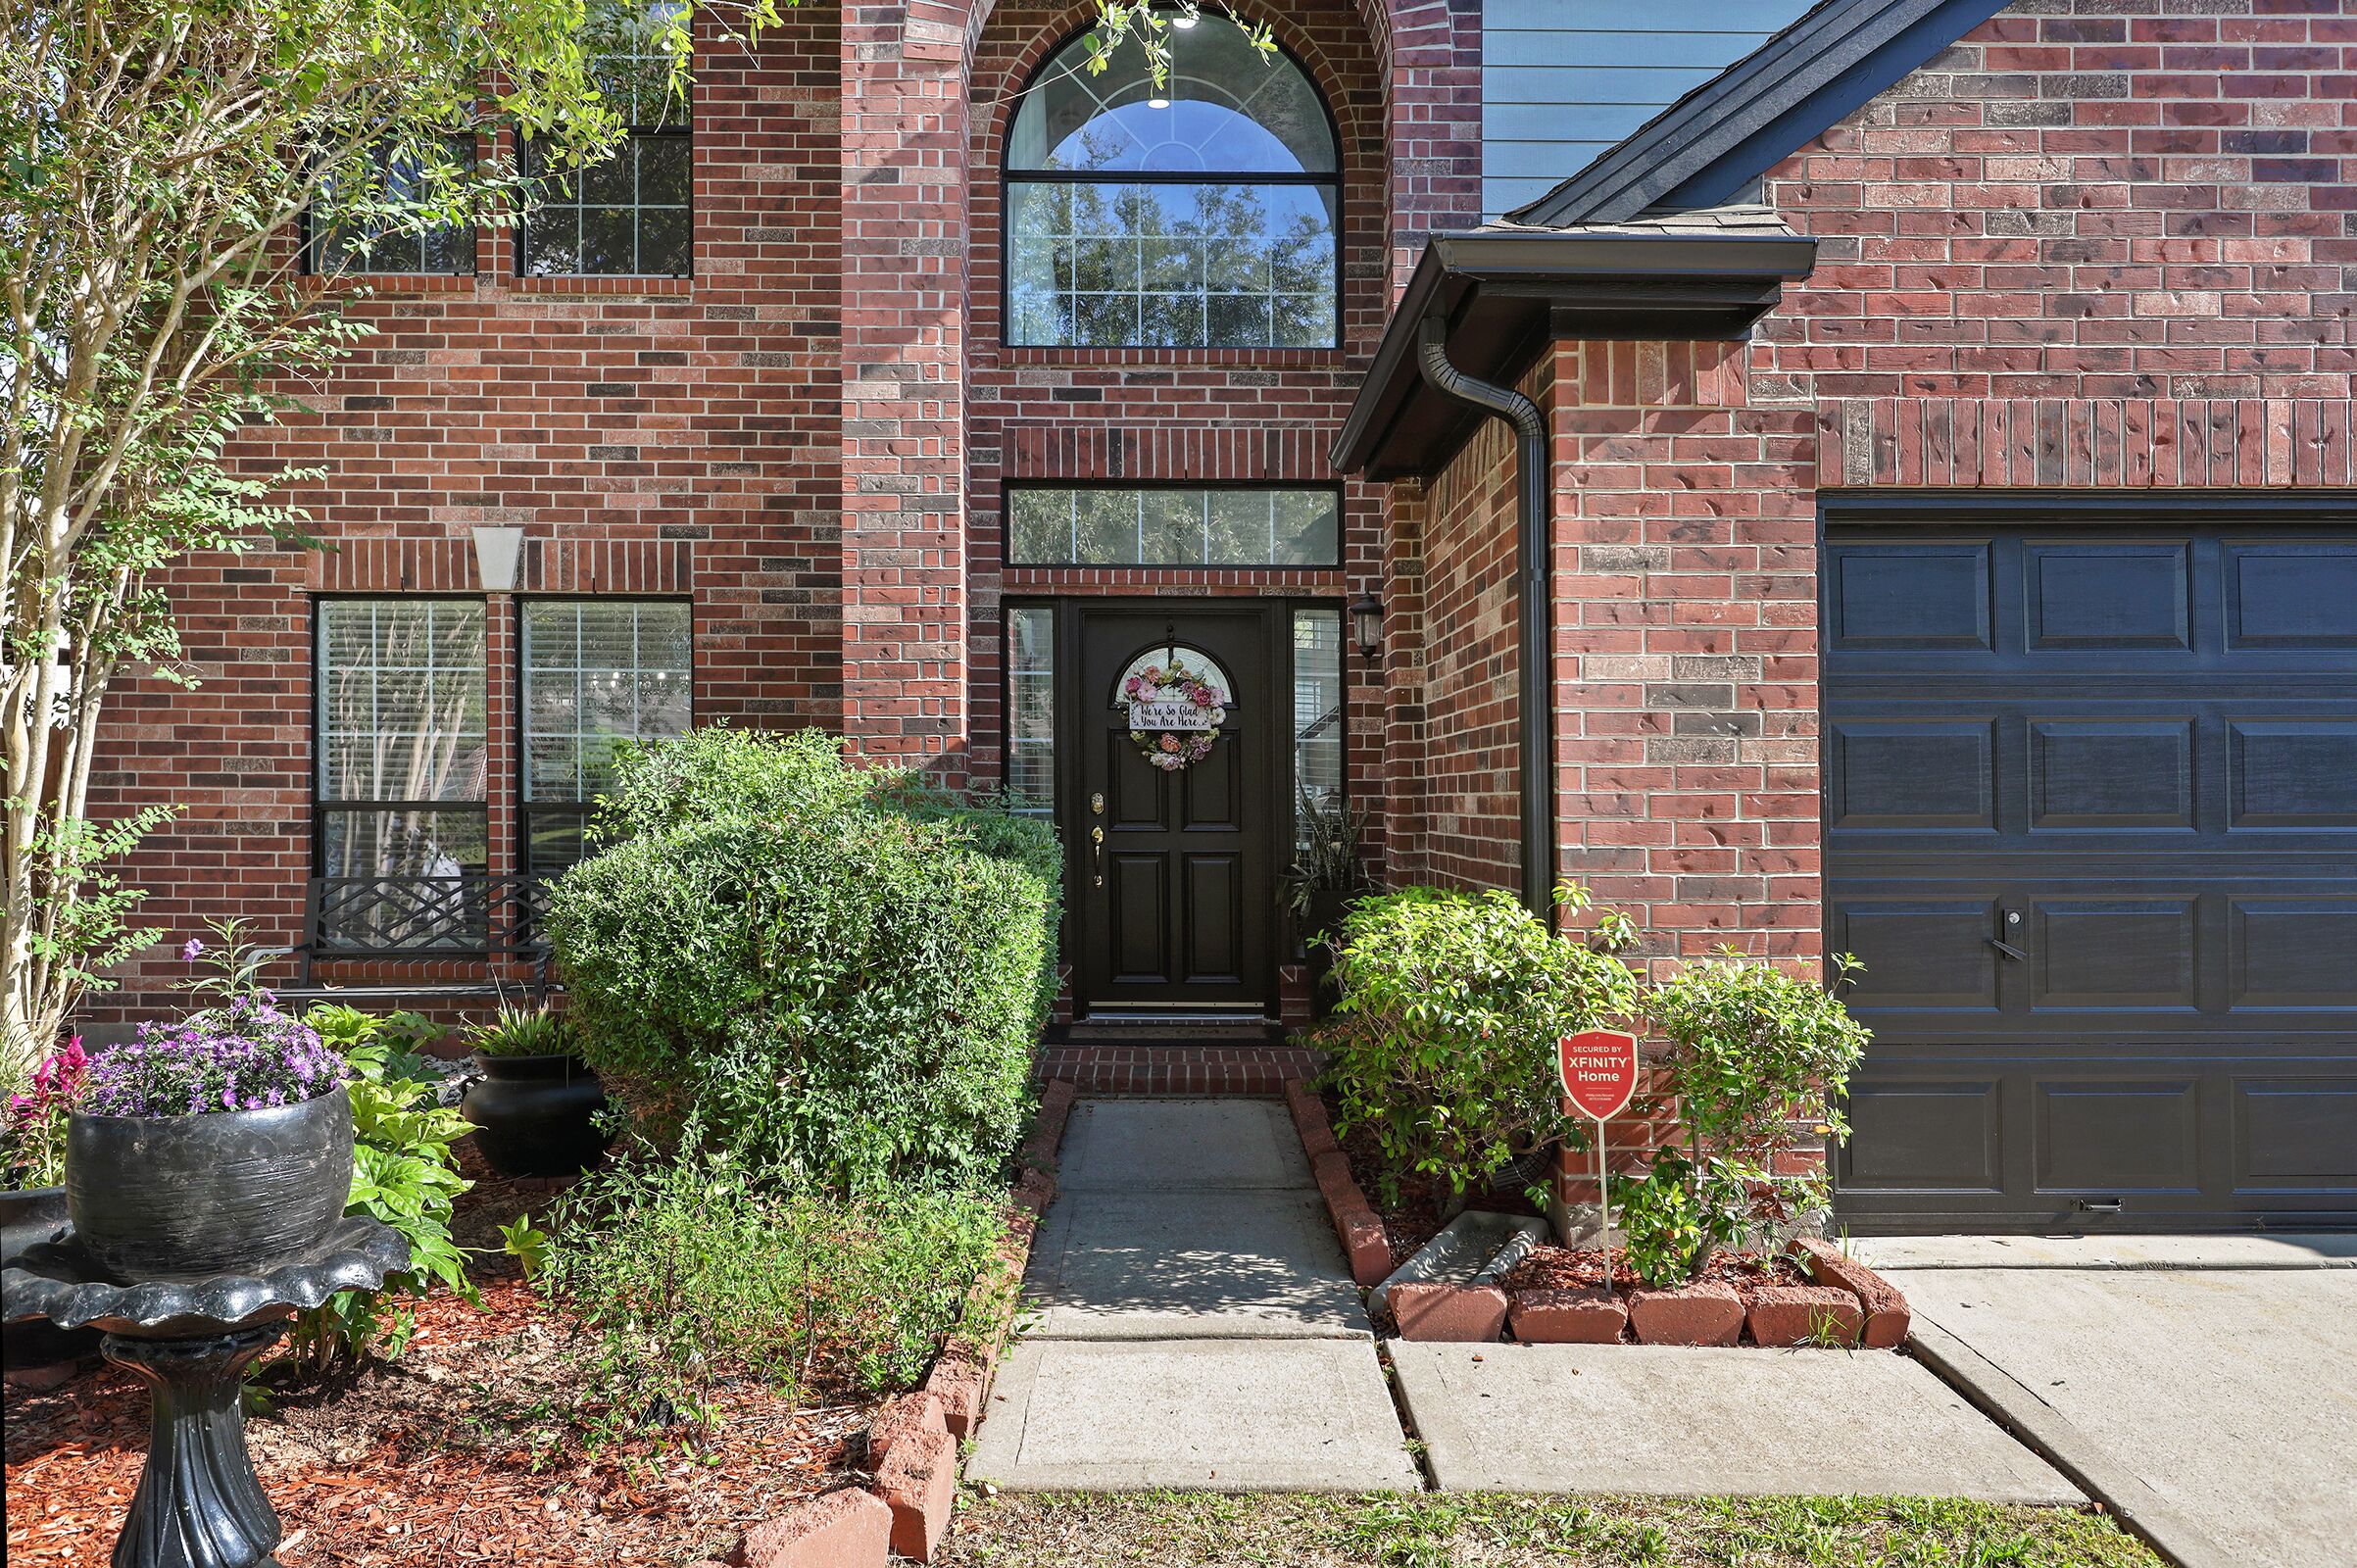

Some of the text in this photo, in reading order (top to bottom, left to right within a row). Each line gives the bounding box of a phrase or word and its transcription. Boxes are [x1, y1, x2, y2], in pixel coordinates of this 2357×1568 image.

[1141, 705, 1199, 716] We're So Glad
[1141, 715, 1201, 726] You Are Here.
[1578, 1070, 1620, 1082] Home
